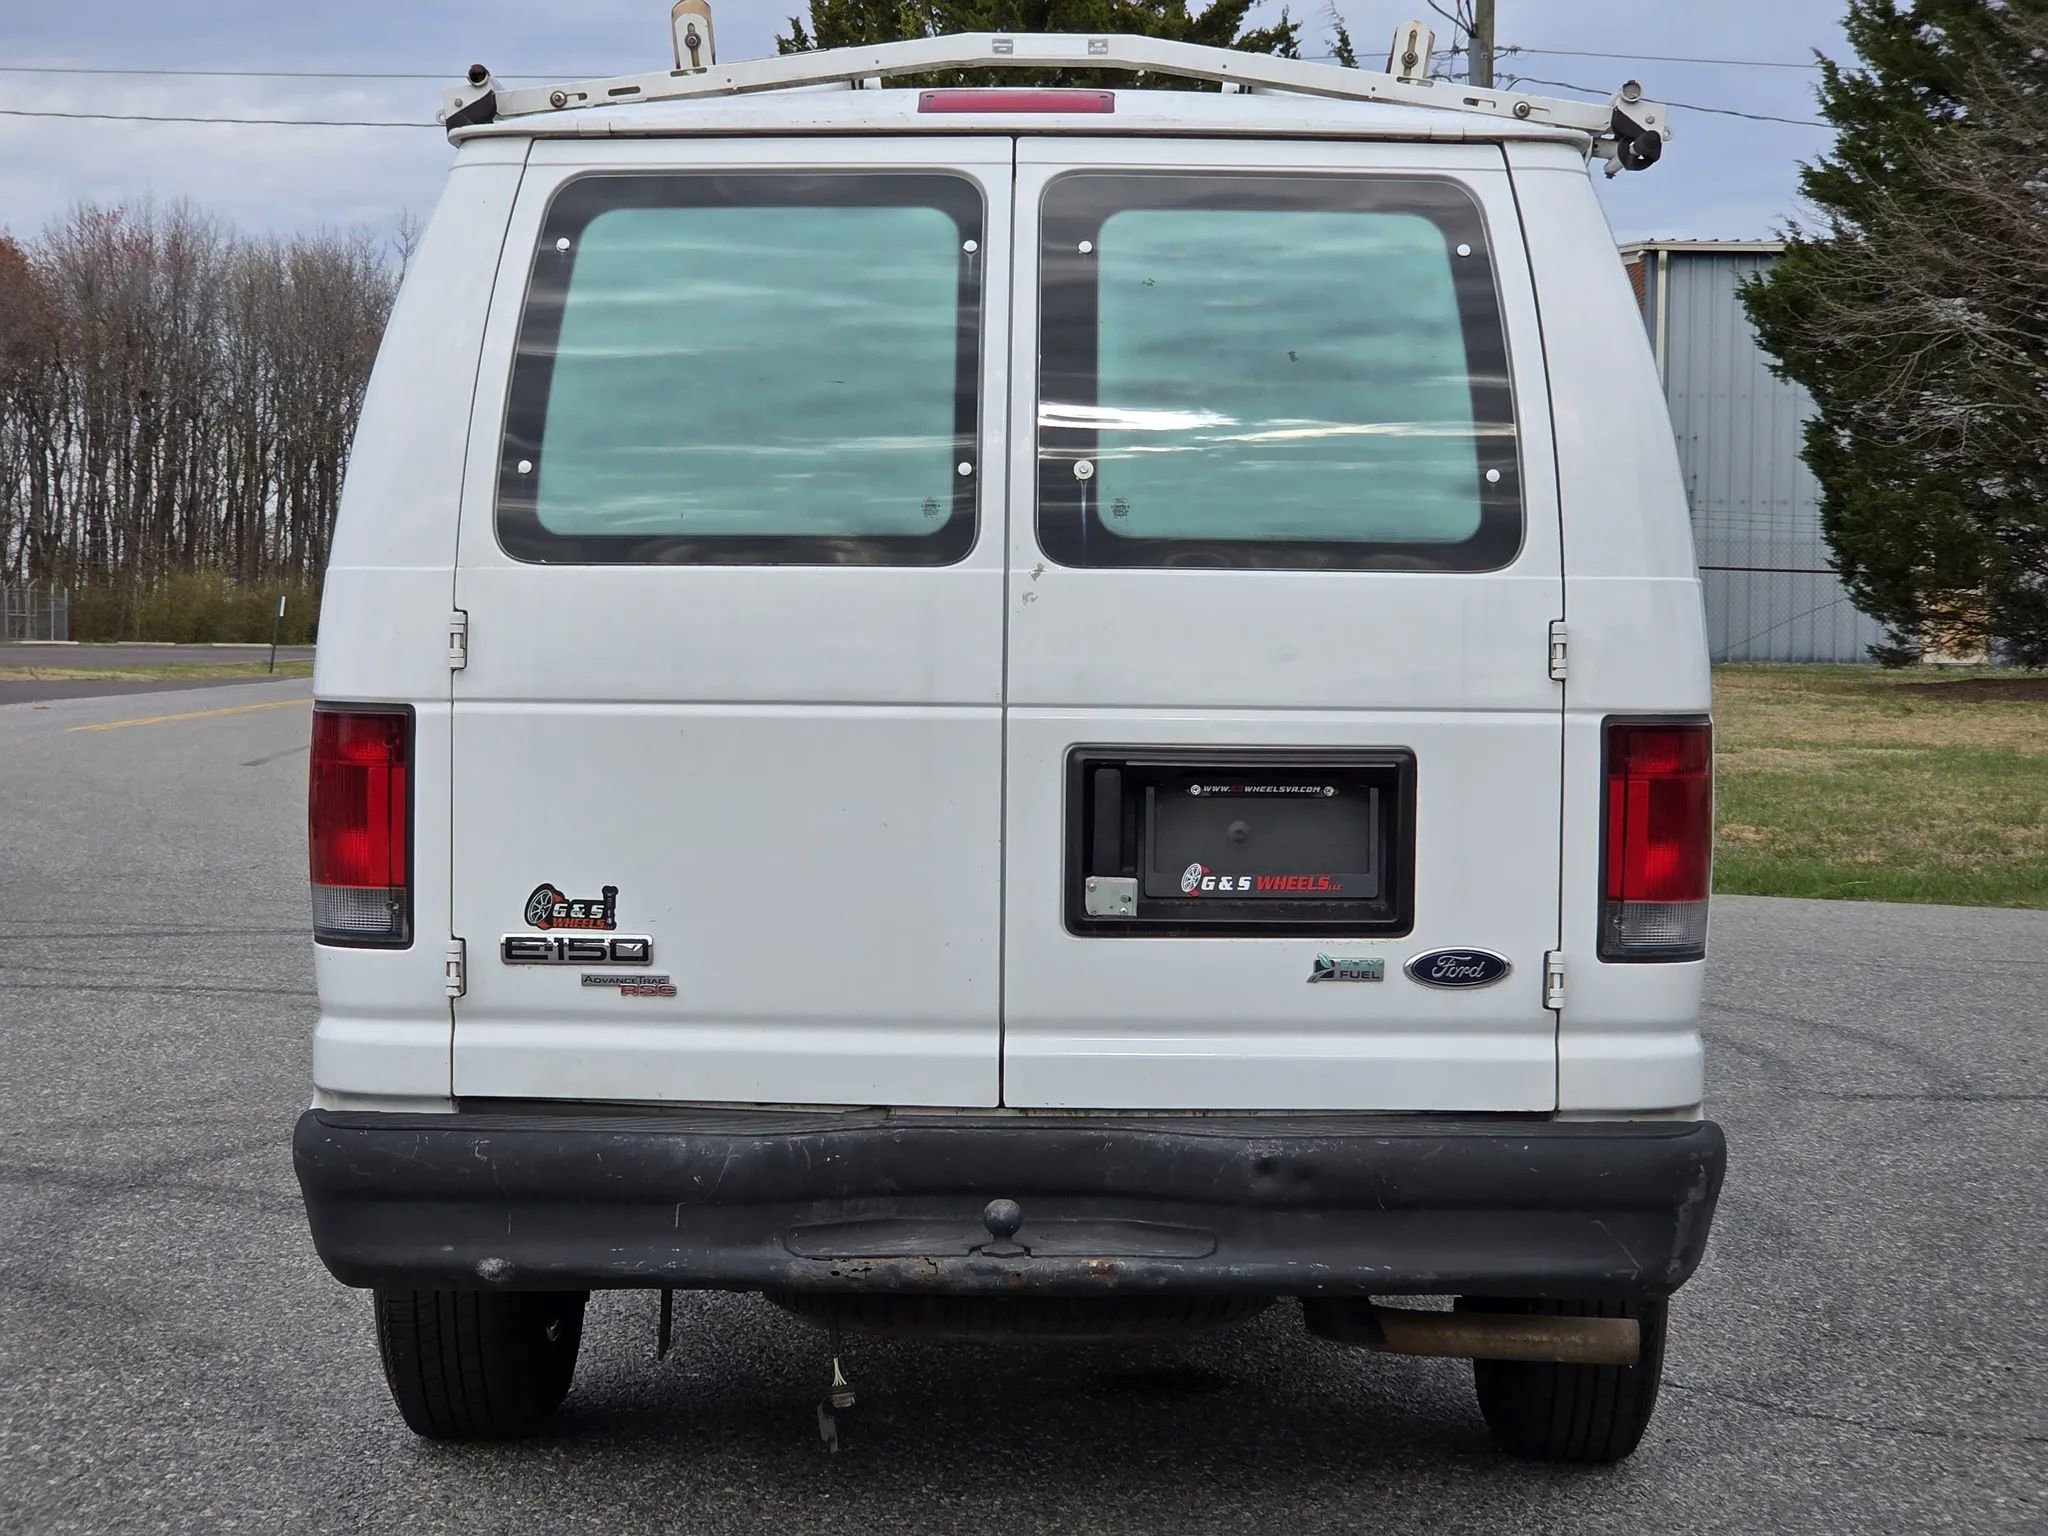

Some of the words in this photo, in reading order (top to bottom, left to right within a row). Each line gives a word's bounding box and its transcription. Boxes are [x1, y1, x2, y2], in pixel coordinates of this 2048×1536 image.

[1201, 876, 1217, 891] G
[1219, 876, 1234, 891] &
[1237, 876, 1252, 891] S
[1256, 875, 1331, 891] WHEELS
[552, 903, 568, 918] G
[570, 904, 585, 918] &
[589, 905, 605, 919] S
[552, 917, 606, 929] WHEELS
[1431, 955, 1486, 978] Ford
[1340, 970, 1381, 979] FUEL
[619, 984, 677, 997] RSC
